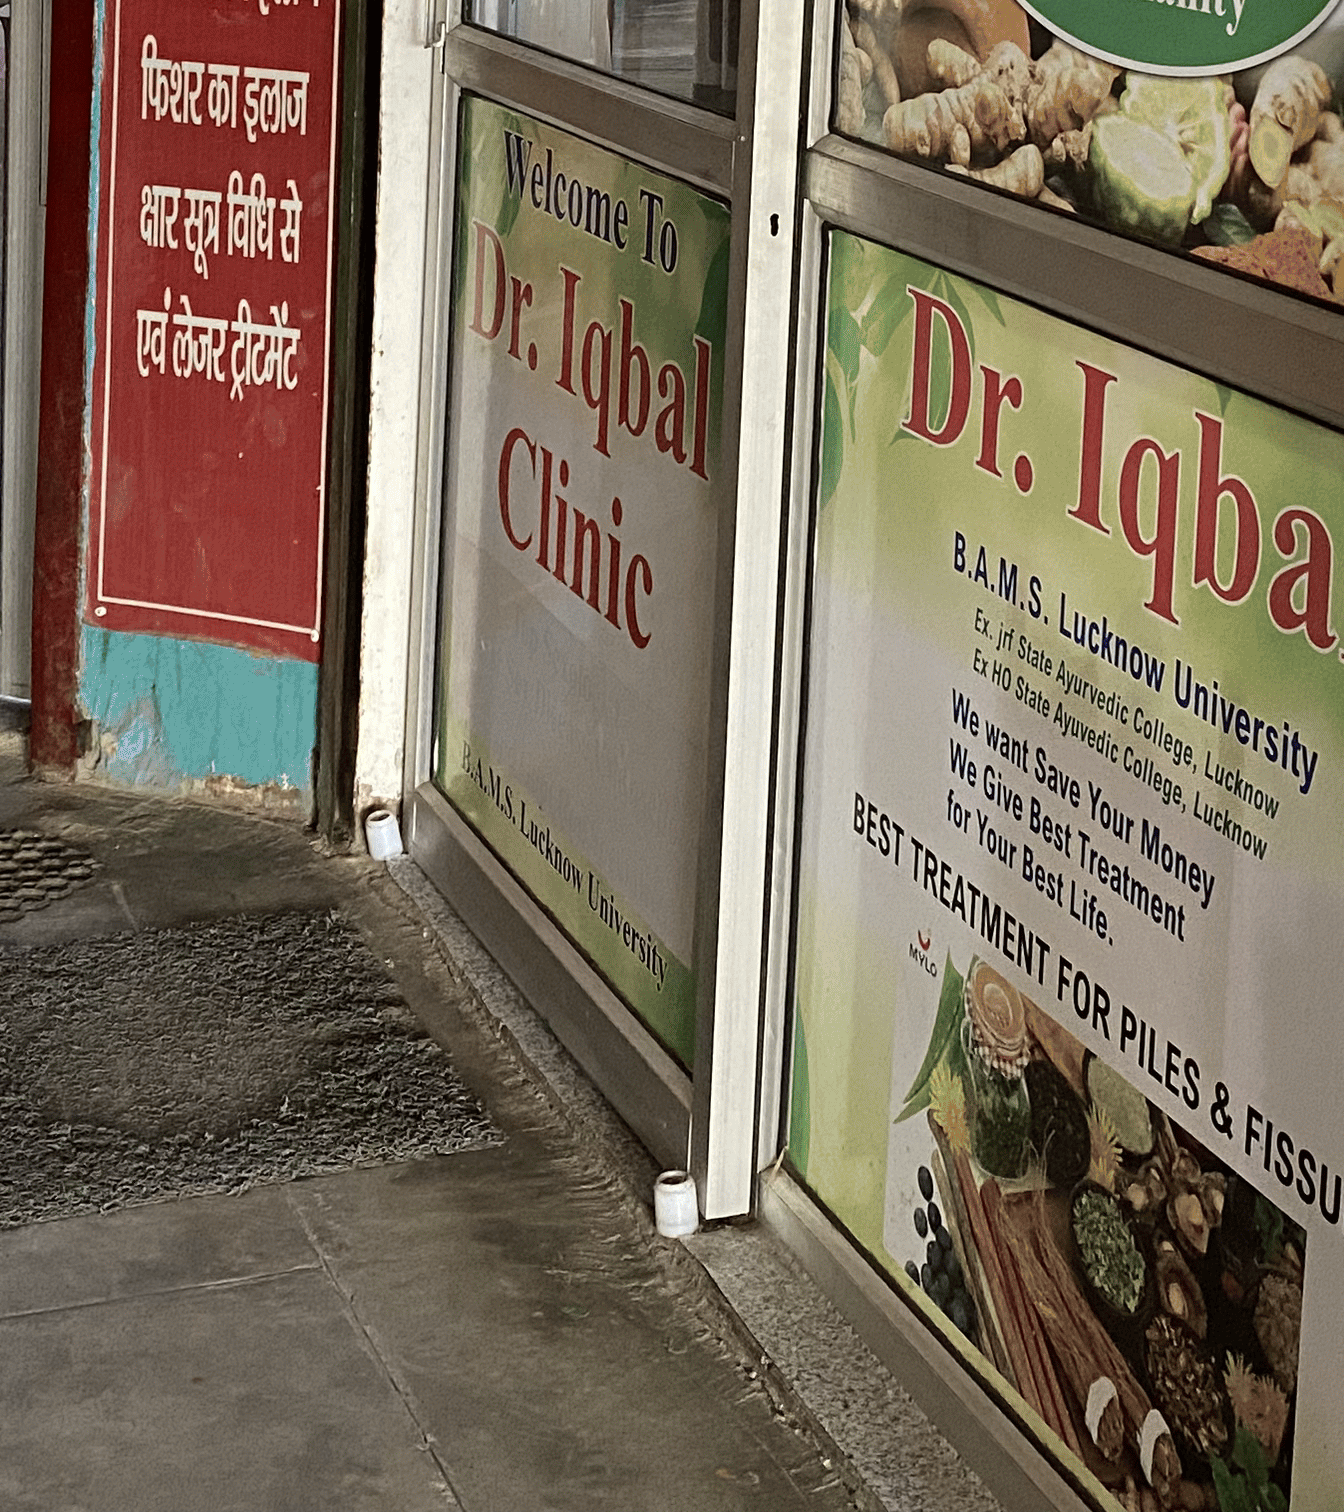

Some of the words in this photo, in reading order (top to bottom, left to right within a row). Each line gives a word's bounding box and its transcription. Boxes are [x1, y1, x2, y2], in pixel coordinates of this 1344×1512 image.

[141, 34, 205, 126] फिशर
[207, 64, 240, 128] का
[243, 68, 310, 142] इलाज
[140, 184, 179, 250] क्षार
[184, 188, 222, 279] सूत्र
[227, 170, 276, 259] विधि
[280, 180, 303, 263] से
[503, 129, 629, 251] Welcome
[639, 188, 677, 273] To
[136, 286, 172, 378] एवं
[172, 294, 229, 383] लेजर
[230, 298, 301, 402] ट्रीटमेंट
[468, 220, 538, 371] Dr.
[555, 264, 710, 482] Iqbal
[901, 285, 1035, 495] Dr.
[498, 426, 652, 649] Clinic
[954, 531, 1048, 625] B.A.M.S.
[1059, 593, 1165, 692] Lucknow
[1174, 659, 1318, 794] University
[974, 608, 993, 640] Ex.
[996, 623, 1014, 652] jrf
[1020, 635, 1053, 677] State
[1056, 660, 1128, 725] Ayurvedic
[1133, 707, 1196, 774] College,
[1205, 751, 1279, 819] Lucknow
[992, 658, 1012, 691] HO
[1016, 676, 1050, 717] State
[1053, 700, 1118, 763] Ayuvedic
[1123, 747, 1186, 813] College,
[1193, 790, 1267, 860] Lucknow
[461, 740, 516, 824] B.A.M.S.
[520, 800, 583, 894] Lucknow
[588, 871, 667, 991] University
[947, 789, 971, 833] for
[976, 808, 1018, 866] Your
[1022, 848, 1063, 907] Best
[1069, 881, 1114, 945] Life.
[950, 738, 977, 786] We
[983, 765, 1023, 821] Give
[1029, 801, 1071, 858] Best
[1077, 829, 1186, 943] Treatment
[952, 688, 980, 736] We
[985, 719, 1029, 774] want
[1035, 745, 1081, 807] Save
[1088, 780, 1134, 842] Your
[1140, 818, 1215, 909] Money
[853, 792, 905, 867] BEST
[910, 835, 1050, 985] TREATMENT
[1057, 954, 1110, 1041] FOR
[1121, 1004, 1201, 1110] PILES
[1210, 1081, 1233, 1139] &
[909, 943, 937, 977] MYLO
